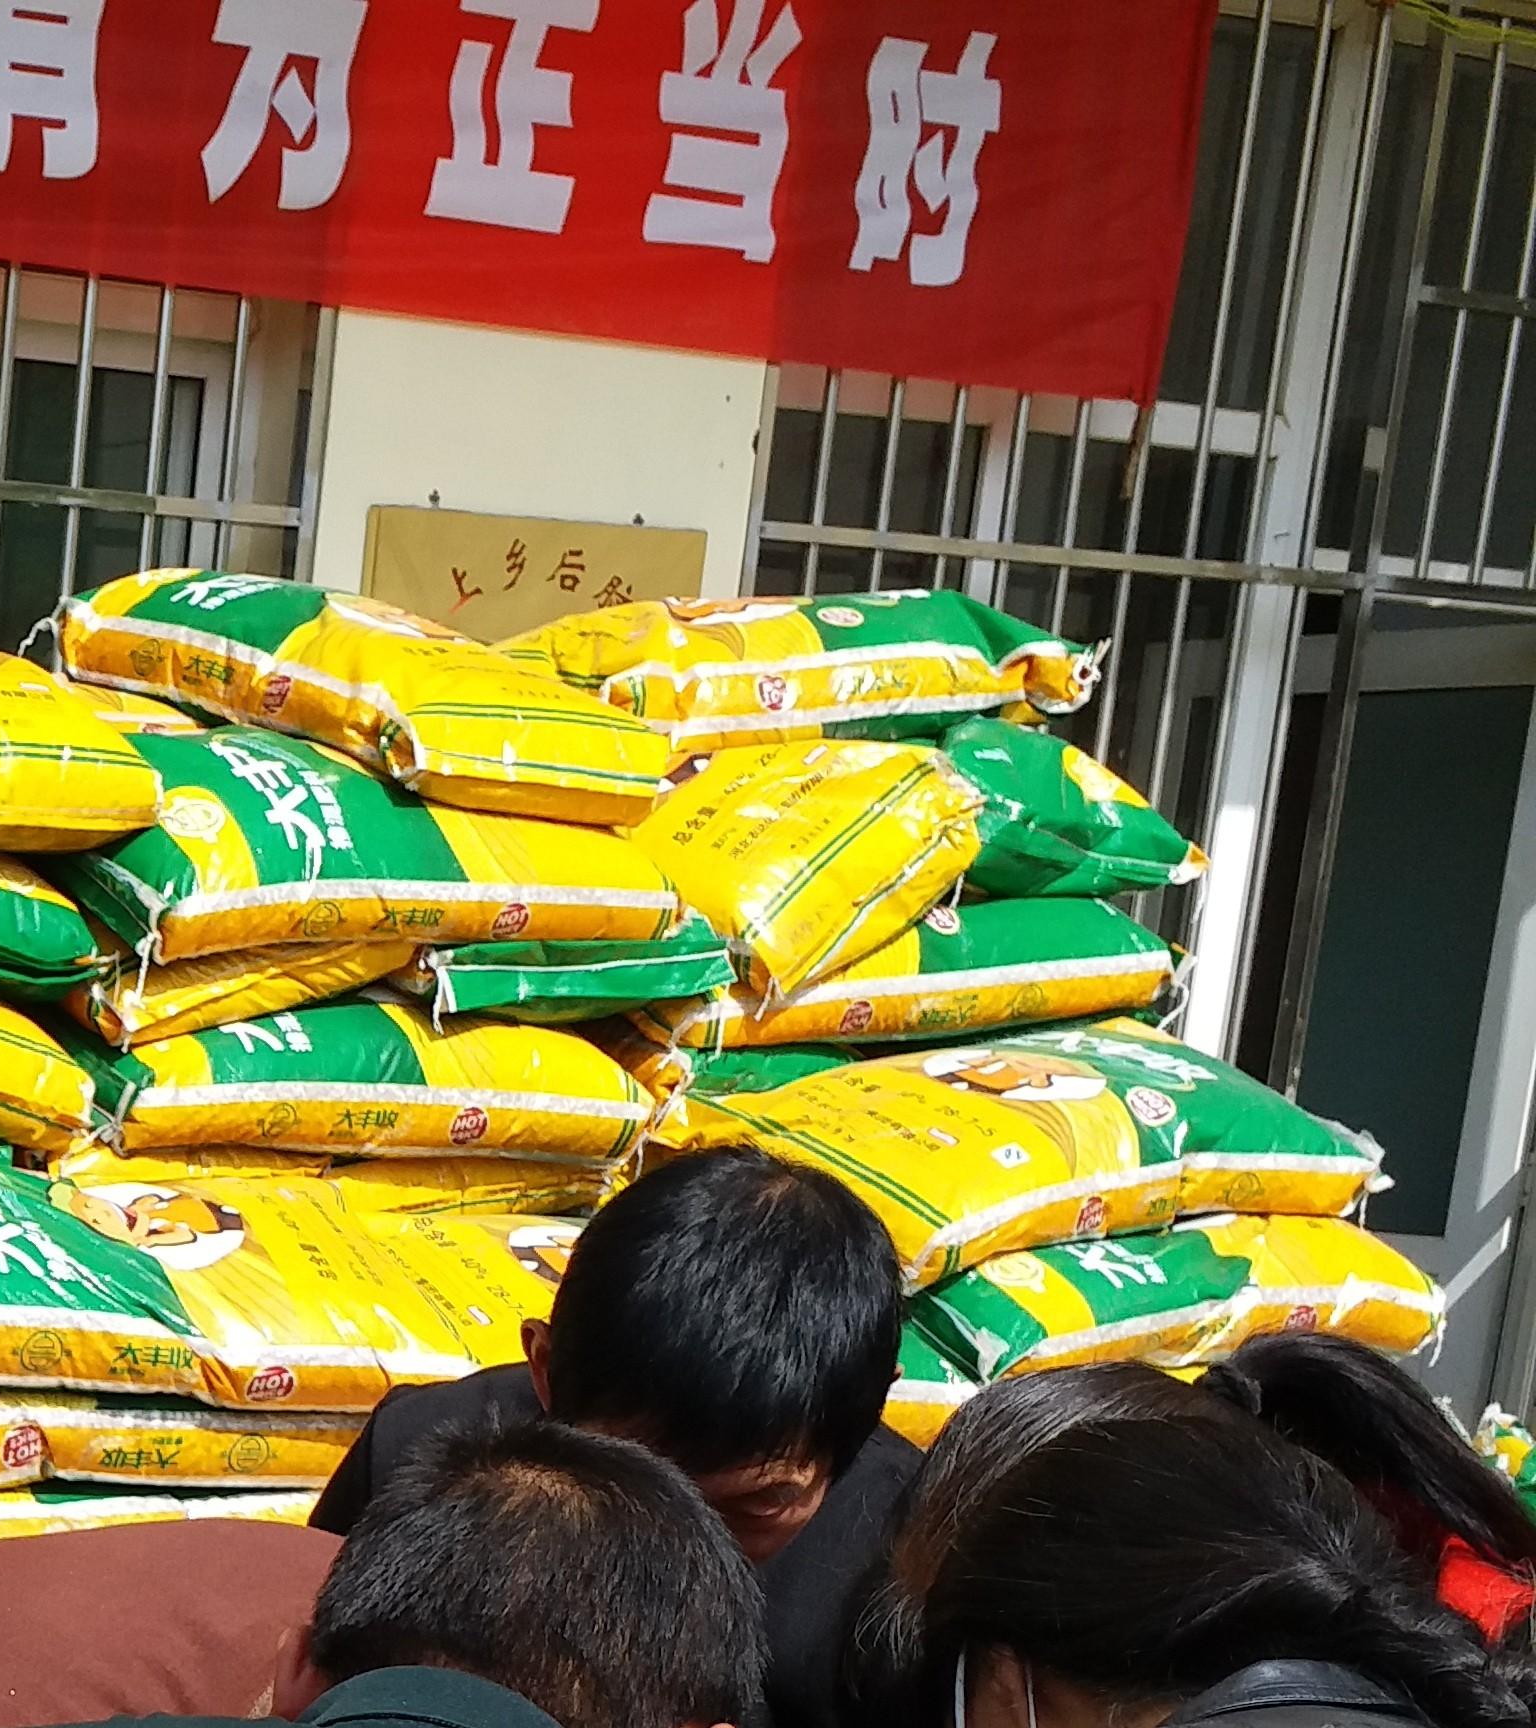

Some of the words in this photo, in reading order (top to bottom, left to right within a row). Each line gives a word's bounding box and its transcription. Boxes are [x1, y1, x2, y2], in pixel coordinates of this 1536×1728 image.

[495, 910, 528, 929] HOT
[331, 1108, 400, 1129] 大丰收
[454, 1113, 486, 1132] HOT
[112, 1342, 194, 1370] 大丰收
[251, 1371, 290, 1392] HOT
[99, 1447, 181, 1469] 大丰收
